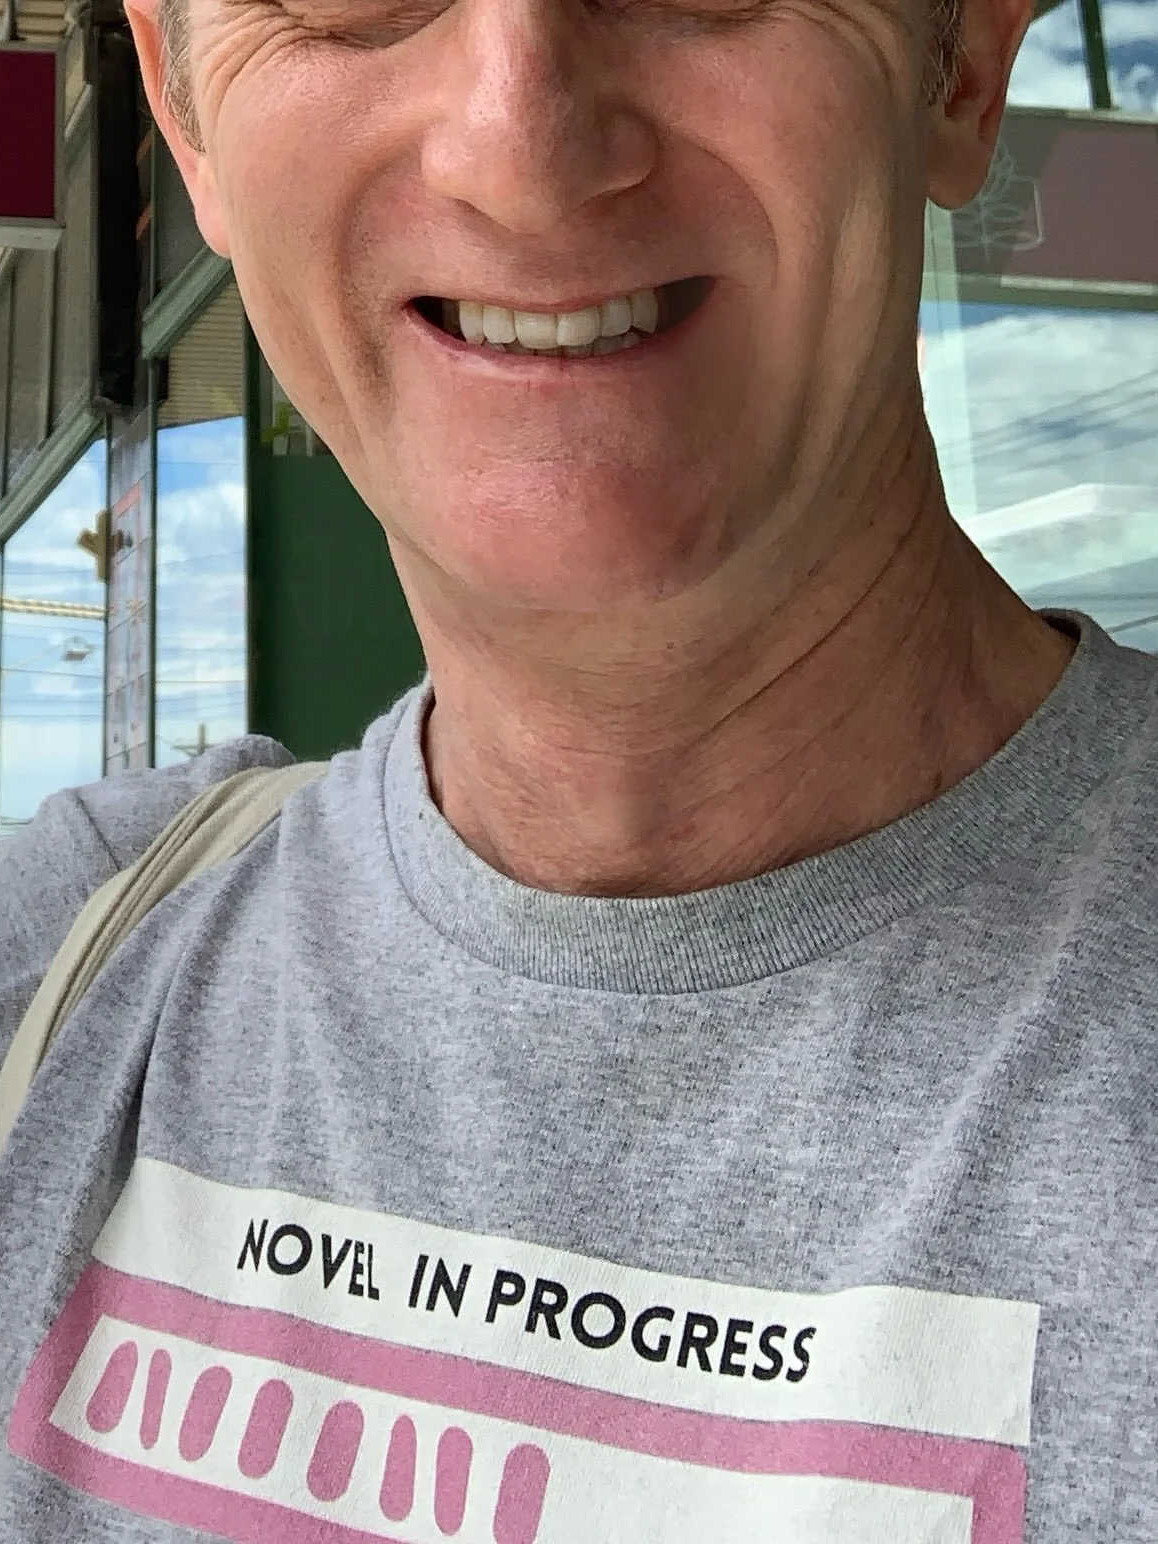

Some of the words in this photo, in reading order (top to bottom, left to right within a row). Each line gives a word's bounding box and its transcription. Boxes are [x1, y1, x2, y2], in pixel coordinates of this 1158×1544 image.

[237, 1219, 381, 1301] NOVEL
[408, 1254, 472, 1318] IN
[485, 1269, 817, 1384] PROGRESS
